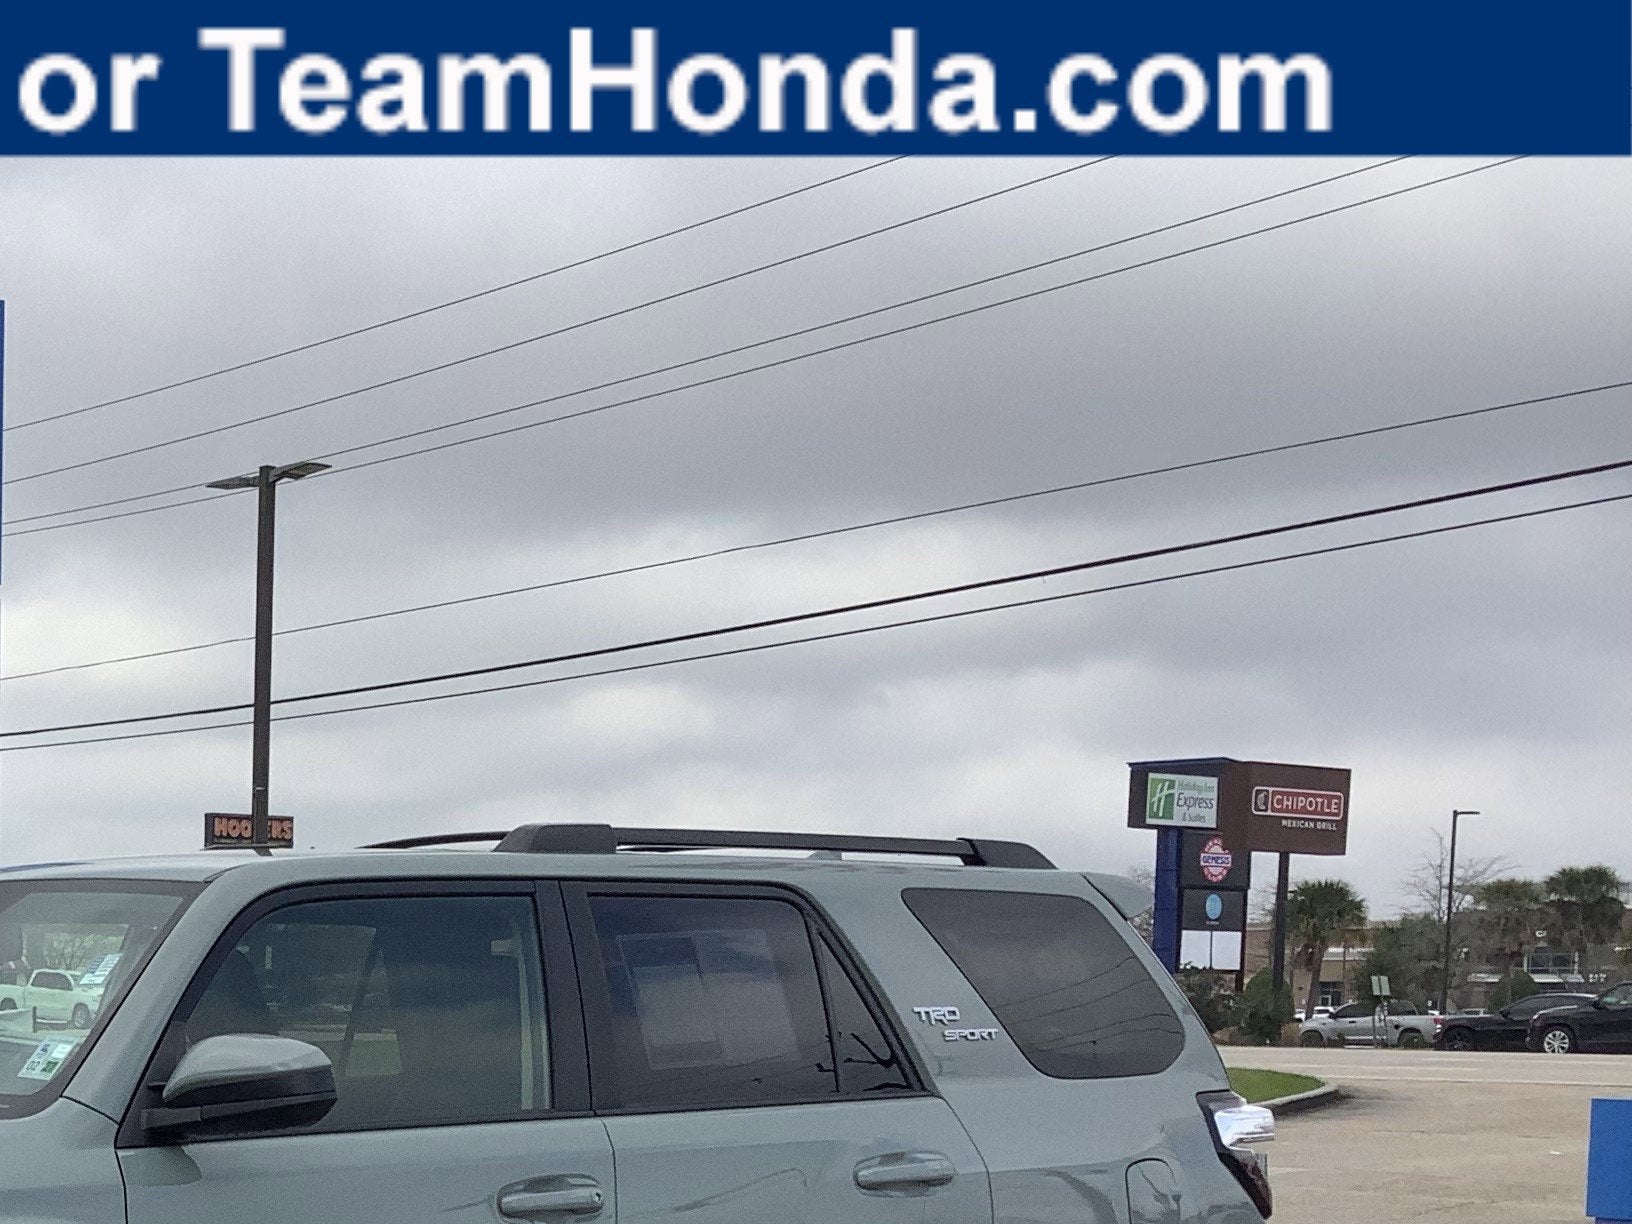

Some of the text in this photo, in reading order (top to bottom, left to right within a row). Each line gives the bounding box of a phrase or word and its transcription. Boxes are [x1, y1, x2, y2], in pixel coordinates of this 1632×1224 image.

[1176, 792, 1214, 811] Express
[1272, 794, 1340, 813] CHIPOTLE
[214, 816, 293, 840] HOORS
[1281, 819, 1337, 831] MEXICAN GRILL
[942, 1028, 999, 1042] SPORT
